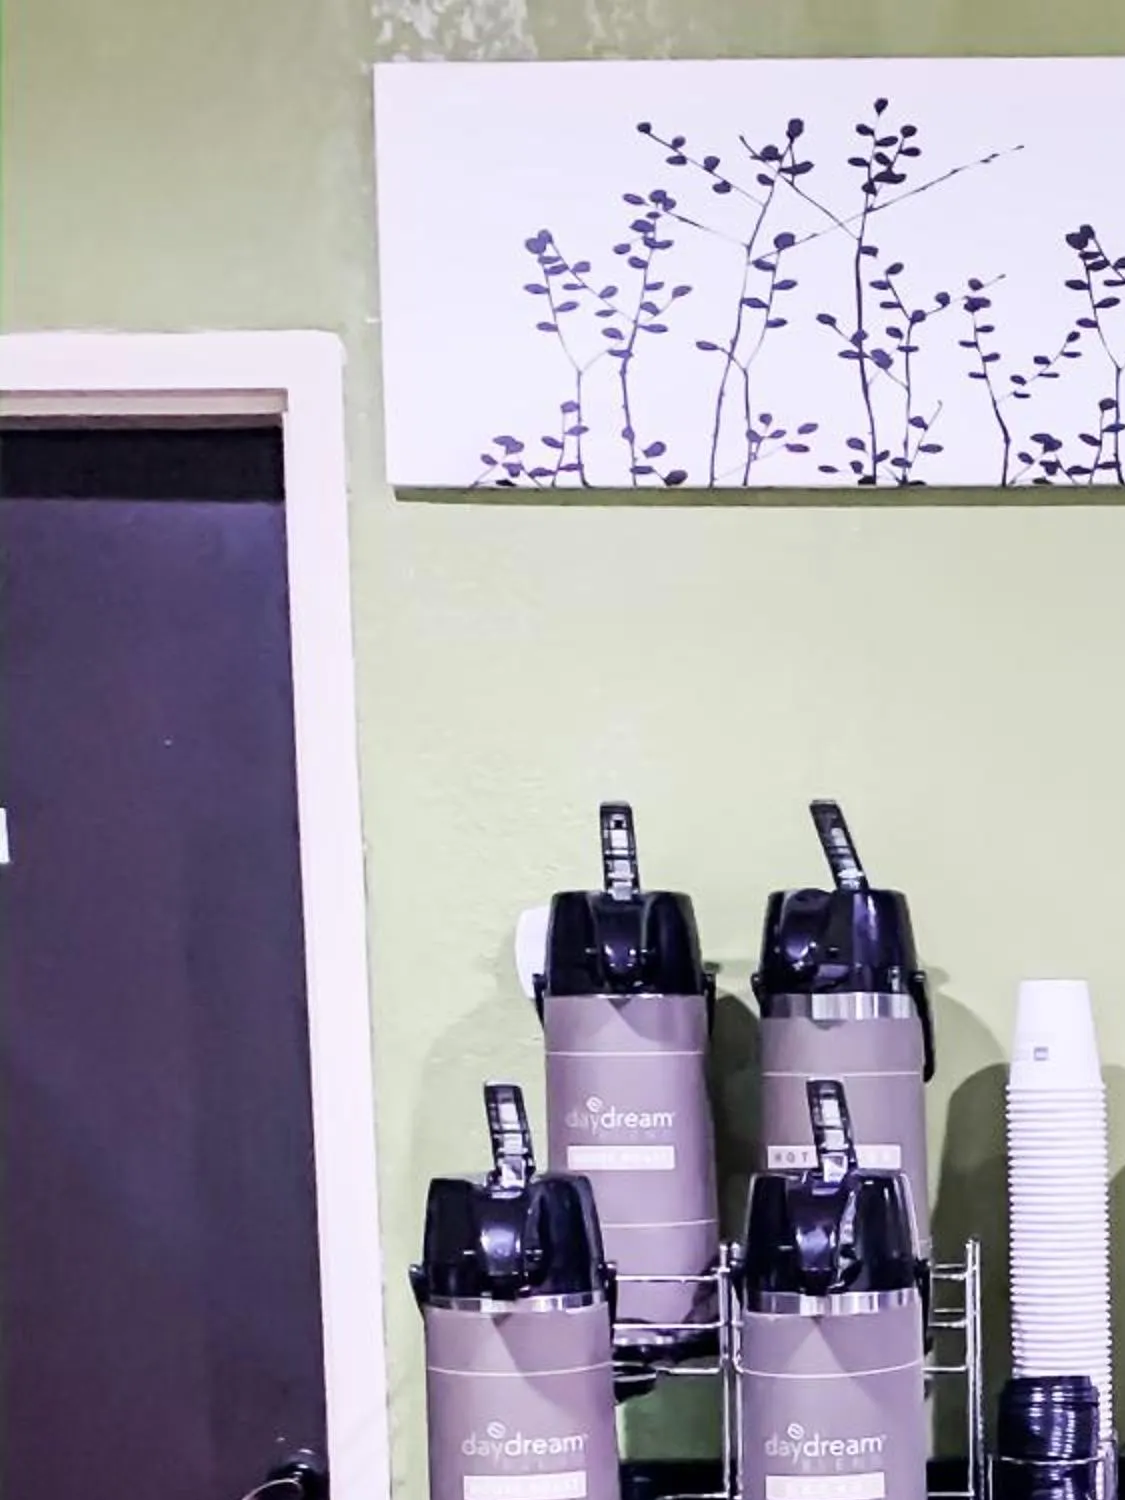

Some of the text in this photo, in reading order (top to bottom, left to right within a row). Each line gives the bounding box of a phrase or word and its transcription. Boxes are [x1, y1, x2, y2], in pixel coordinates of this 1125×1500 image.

[565, 1105, 675, 1136] daydream
[461, 1430, 585, 1468] daydream
[764, 1432, 883, 1465] daydream
